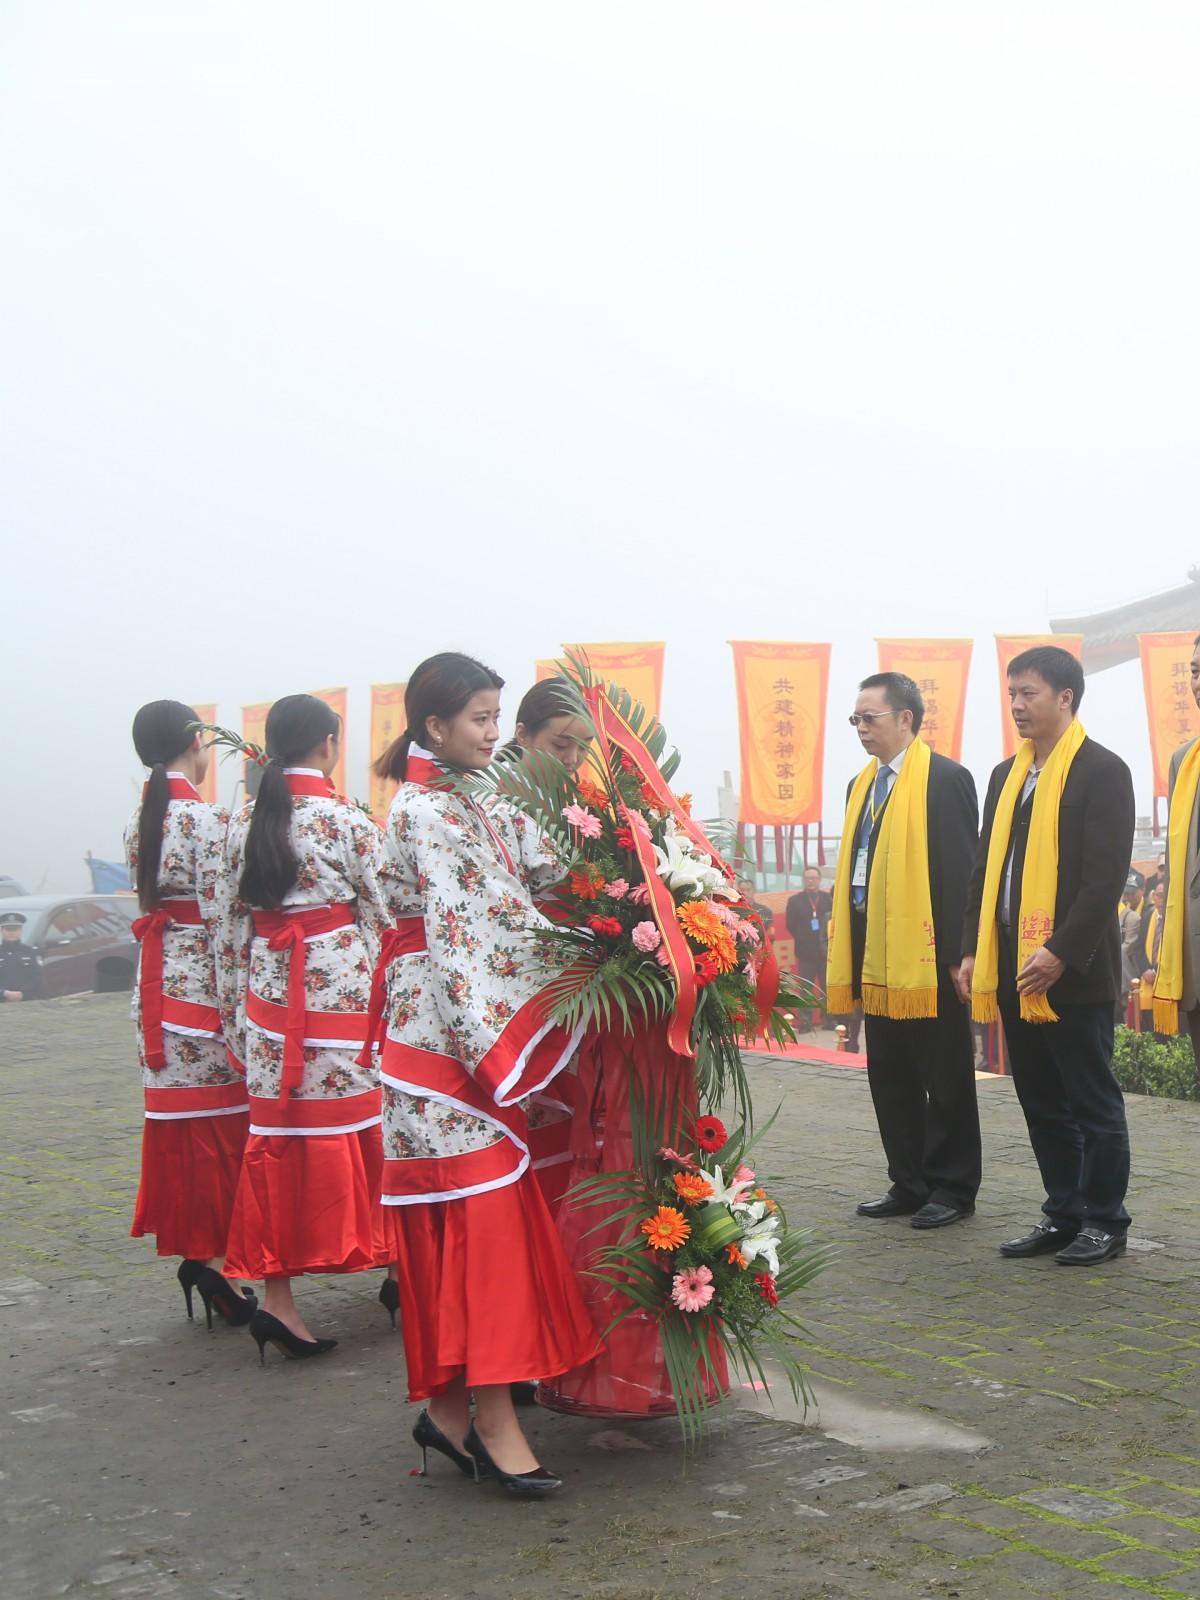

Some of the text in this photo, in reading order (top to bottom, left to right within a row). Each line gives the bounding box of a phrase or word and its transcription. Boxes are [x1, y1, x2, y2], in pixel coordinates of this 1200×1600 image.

[773, 677, 795, 800] 共建精神家园
[917, 678, 939, 752] 拜谒华
[1170, 662, 1192, 744] 拜谒华夏
